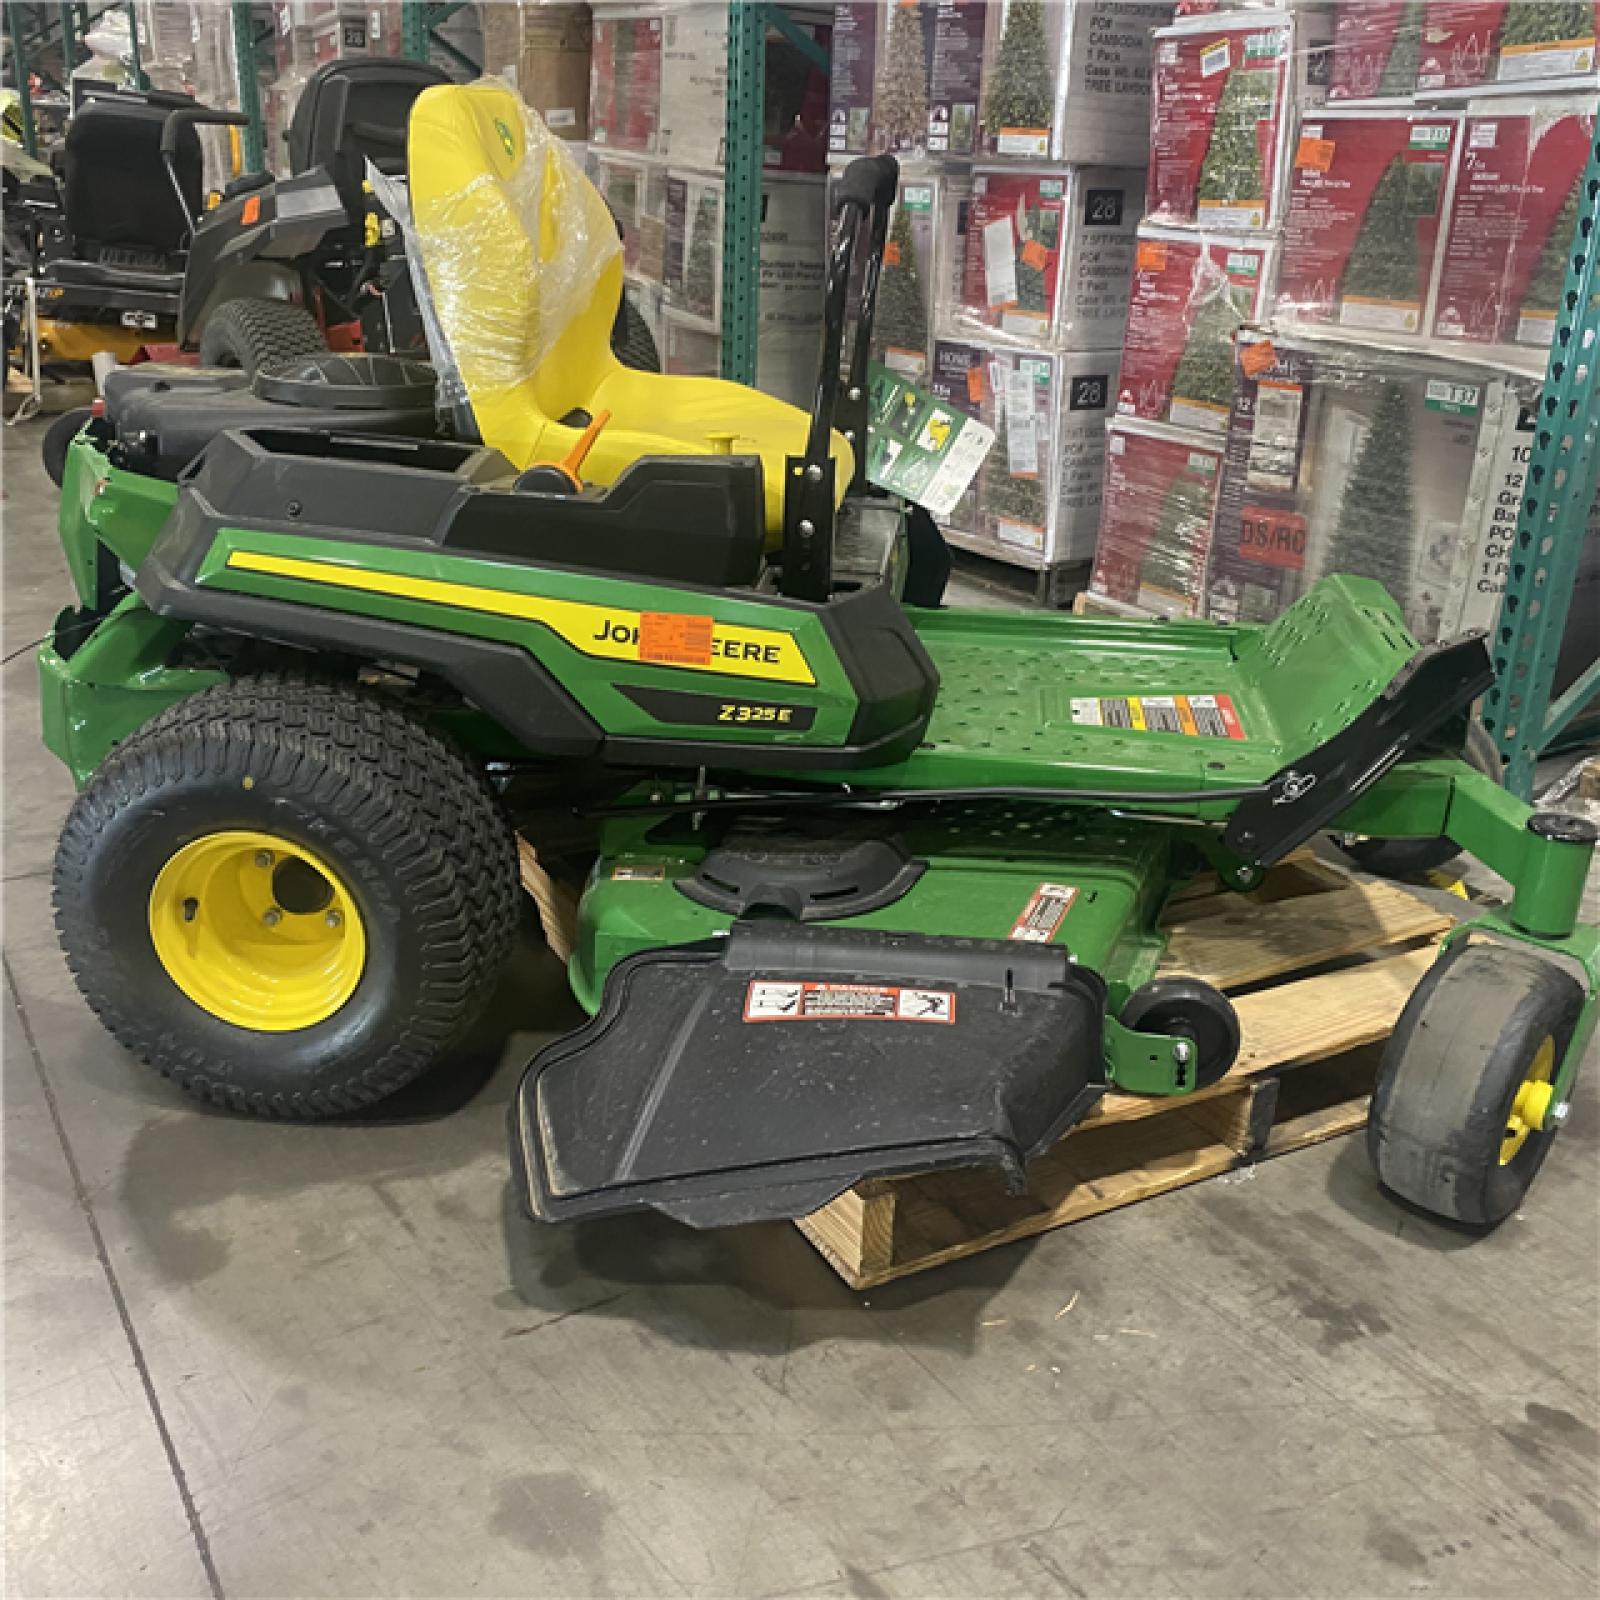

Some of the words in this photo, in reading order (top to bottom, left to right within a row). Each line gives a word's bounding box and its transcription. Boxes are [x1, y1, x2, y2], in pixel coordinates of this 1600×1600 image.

[1091, 197, 1116, 219] 28
[1077, 382, 1101, 405] 28
[1505, 473, 1523, 488] 12
[712, 639, 781, 664] EERE
